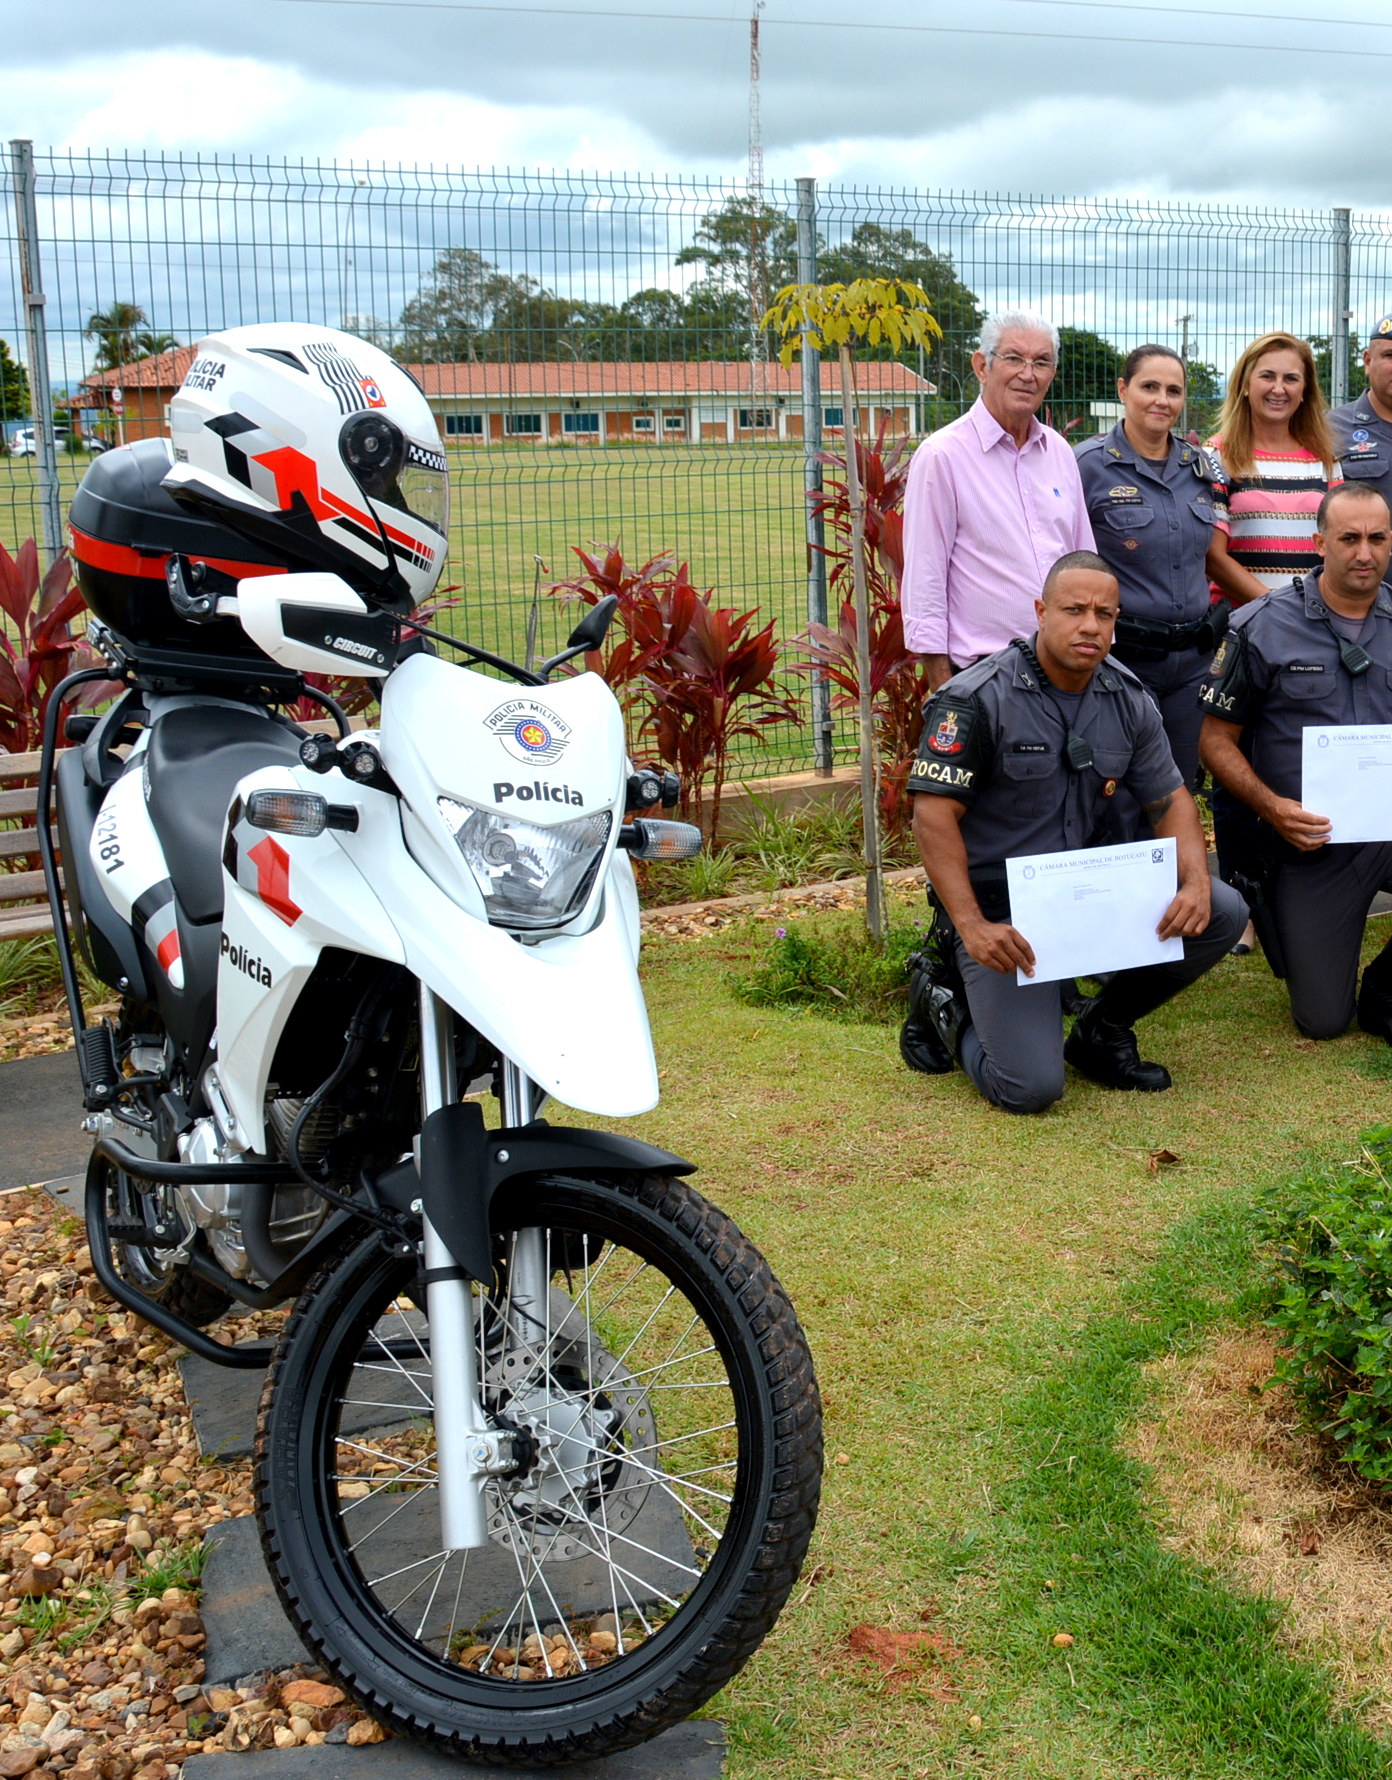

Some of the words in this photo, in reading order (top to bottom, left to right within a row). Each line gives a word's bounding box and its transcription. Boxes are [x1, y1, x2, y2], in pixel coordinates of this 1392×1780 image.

[190, 358, 226, 379] LÍCIA
[184, 374, 217, 392] LITAR
[333, 637, 378, 660] CIRCUIT
[530, 702, 567, 733] MILITAR
[911, 759, 974, 789] ROCAM
[493, 781, 584, 807] Polícia
[1039, 862, 1068, 871] CÂMARA
[1069, 858, 1103, 868] MUNICIPAL
[1114, 852, 1147, 861] BOTUCATU
[220, 930, 272, 989] Polícia
